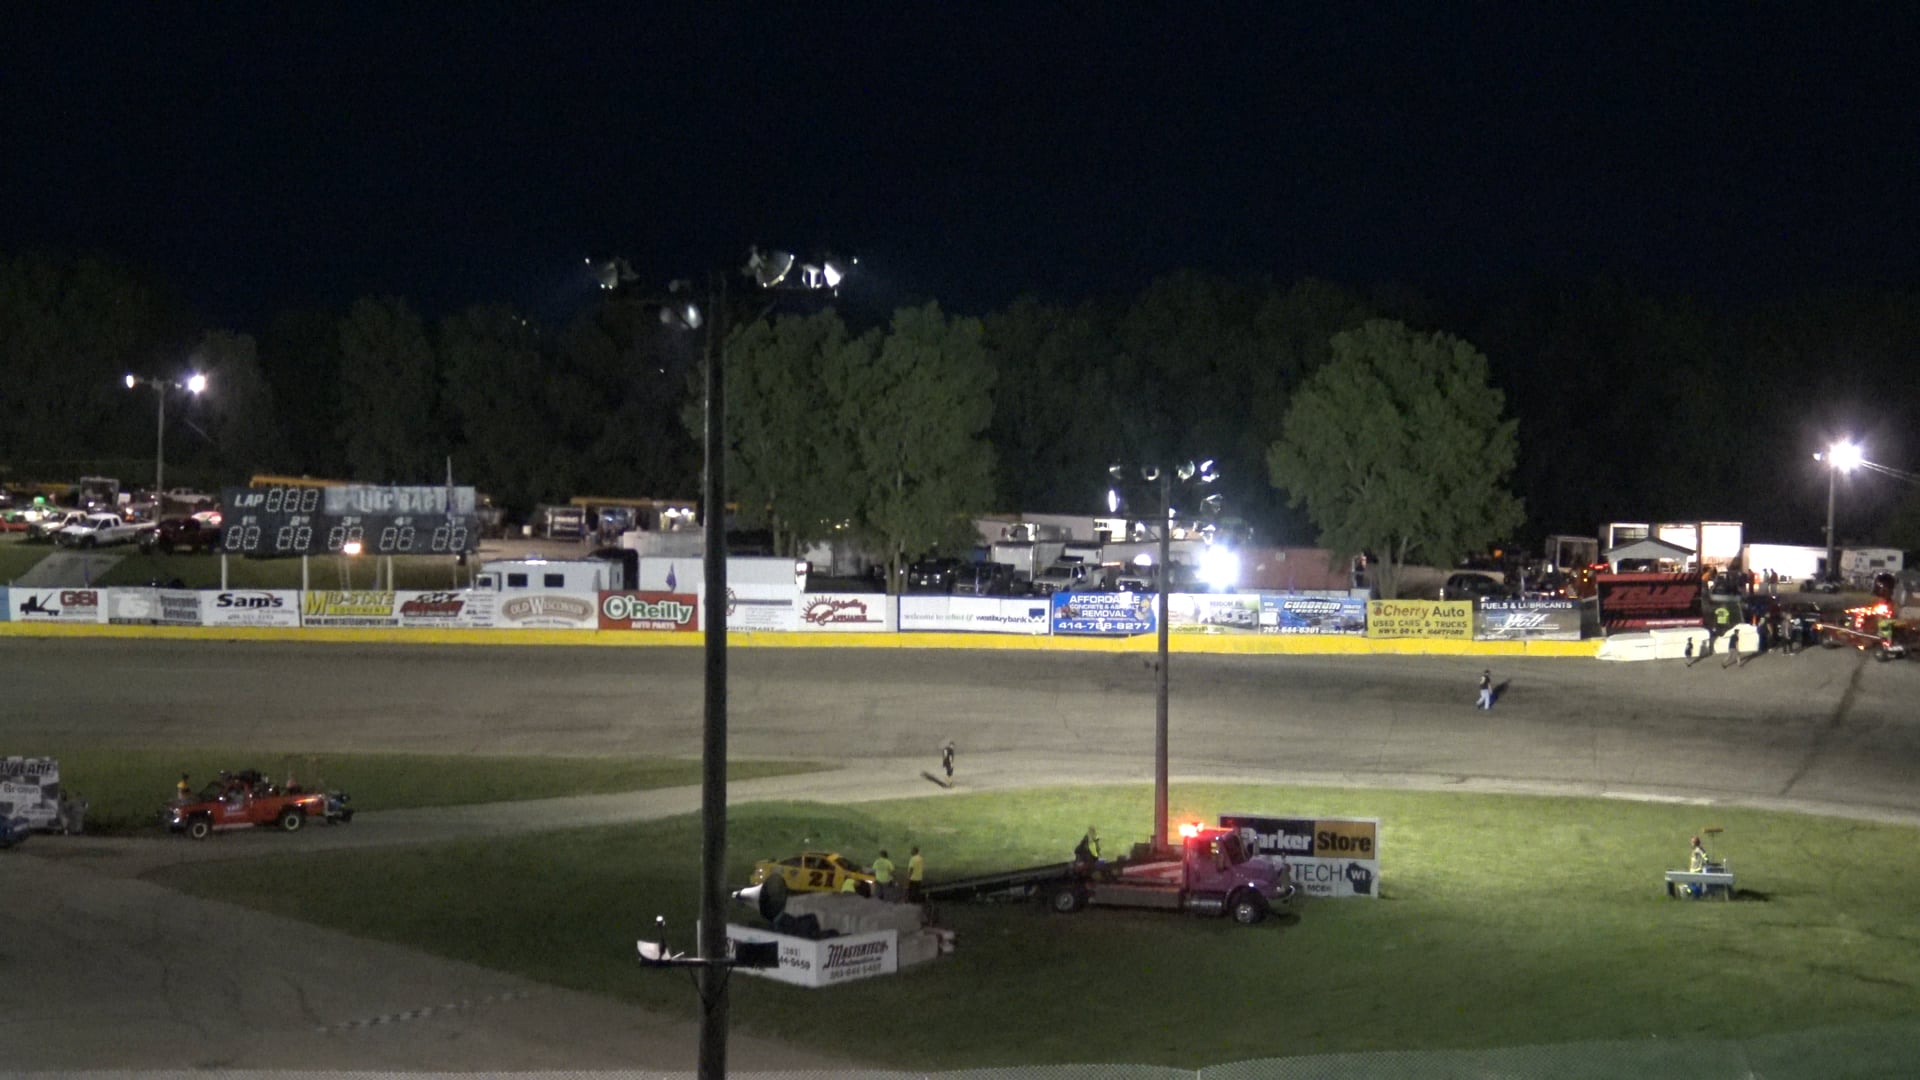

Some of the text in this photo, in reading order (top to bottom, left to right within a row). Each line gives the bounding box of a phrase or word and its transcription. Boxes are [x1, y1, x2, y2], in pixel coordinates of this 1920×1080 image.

[234, 493, 264, 507] LAP
[1069, 595, 1140, 604] AFFORDAE
[1283, 600, 1342, 610] GUNDRUM
[510, 603, 528, 614] OLD
[603, 595, 693, 624] O'Reilly
[1082, 609, 1127, 617] REMOVAL
[1383, 604, 1465, 618] Cherry Auto
[652, 621, 676, 630] PARTS
[1372, 620, 1395, 628] USED
[1398, 620, 1421, 628] CARS
[1240, 827, 1371, 852] Parker Store
[808, 871, 835, 887] 21
